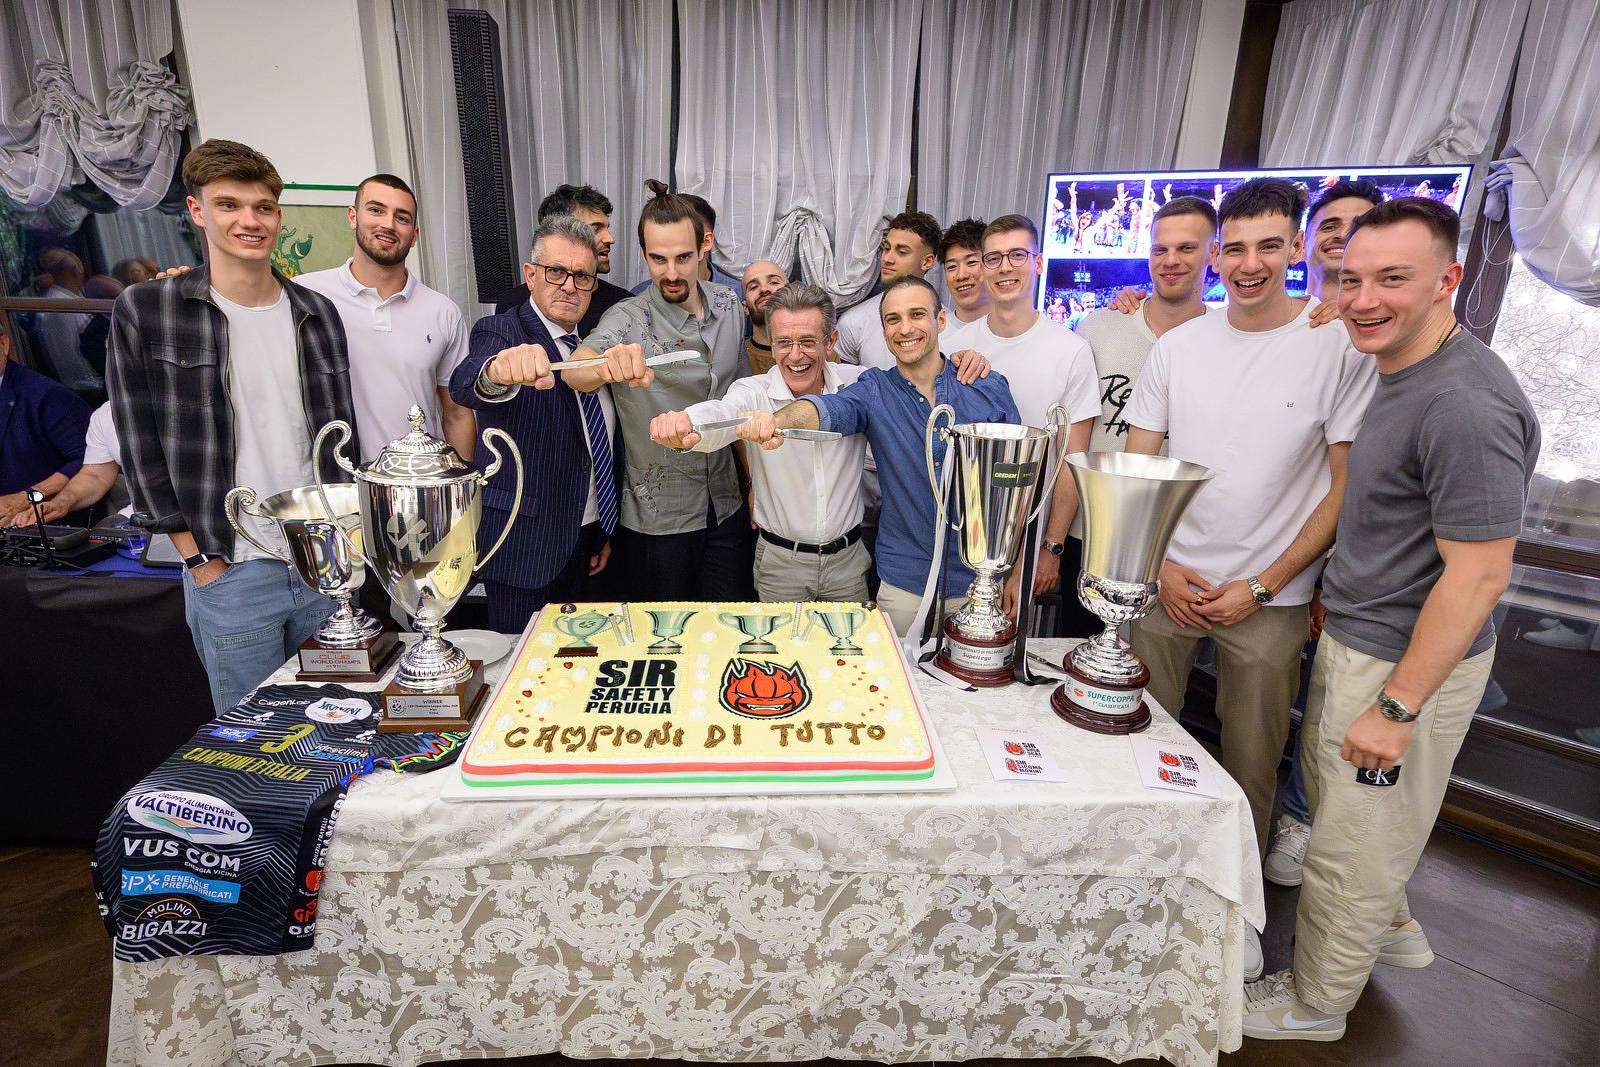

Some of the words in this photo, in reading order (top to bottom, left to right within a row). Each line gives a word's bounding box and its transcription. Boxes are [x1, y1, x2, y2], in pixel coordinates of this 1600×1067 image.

[596, 660, 677, 687] SIR
[590, 688, 675, 701] SAFETY
[1087, 690, 1135, 702] SUPERCOPPA
[585, 702, 672, 714] PERUGIA
[260, 724, 316, 753] 3
[504, 721, 684, 752] CAMPIONI
[704, 724, 742, 748] DI
[770, 720, 886, 747] TUTTO
[182, 748, 256, 770] CAMPIONI
[246, 759, 312, 782] D'ITALIA
[135, 795, 250, 834] VALTIBERINO
[158, 792, 186, 804] GRUPPO
[185, 799, 236, 818] ALIMENTARE
[124, 837, 180, 857] VUS
[186, 848, 240, 872] COM
[184, 862, 212, 874] ENERGIA
[214, 869, 237, 878] VICINA
[162, 882, 232, 899] PREFABBRICATI
[163, 874, 209, 889] GENERALE
[146, 902, 192, 918] MOLINO
[122, 920, 208, 940] BIGAZZI
